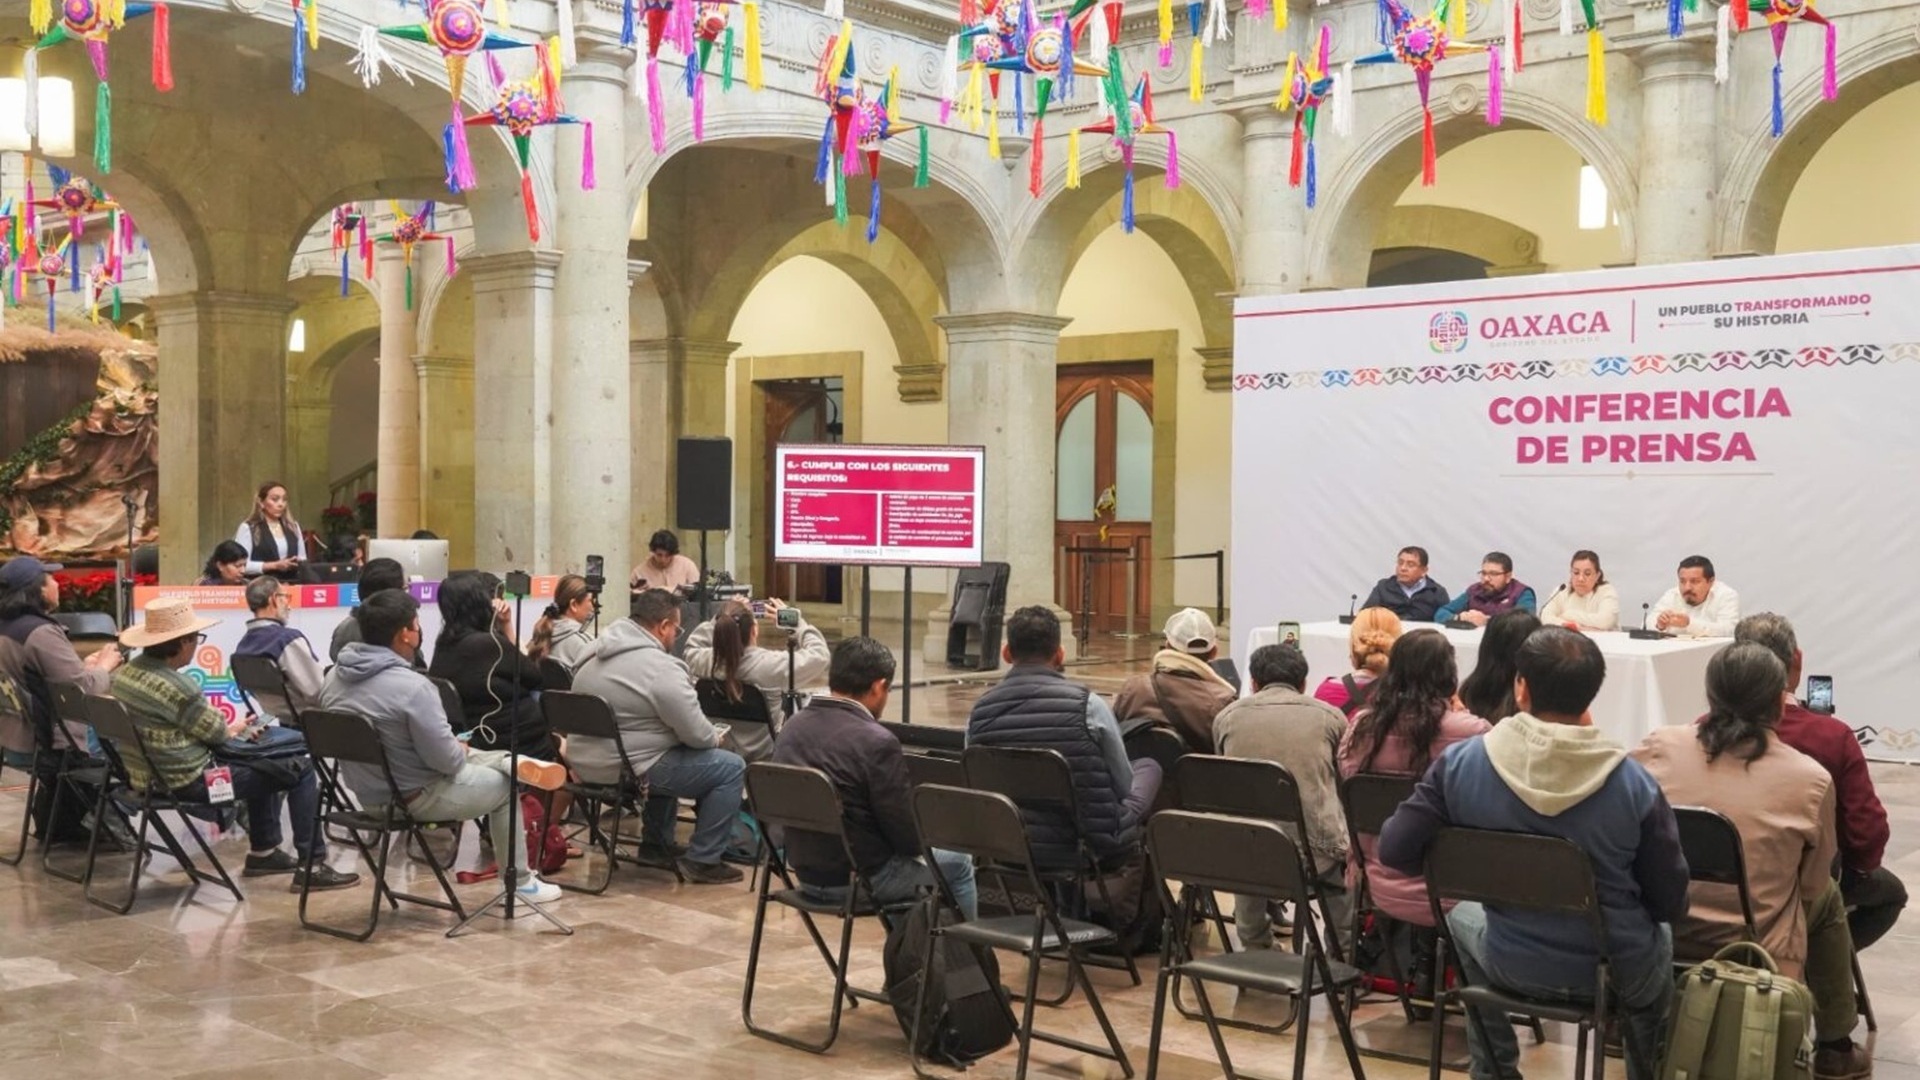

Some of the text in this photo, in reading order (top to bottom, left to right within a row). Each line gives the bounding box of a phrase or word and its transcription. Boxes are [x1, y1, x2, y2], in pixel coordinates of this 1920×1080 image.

[1658, 293, 1872, 318] UN PUEBLO TRANSFORMANDO
[1479, 310, 1611, 340] OAXACA
[1714, 312, 1810, 329] SU HISTORIA
[1488, 387, 1792, 425] CONFERENCIA
[1516, 431, 1757, 464] DE PRENSA
[786, 473, 848, 484] REQUISITOS:
[801, 460, 846, 470] CUMPLIR
[847, 461, 869, 471] CON
[870, 462, 891, 471] LOS
[892, 462, 950, 472] SIGUIENTES
